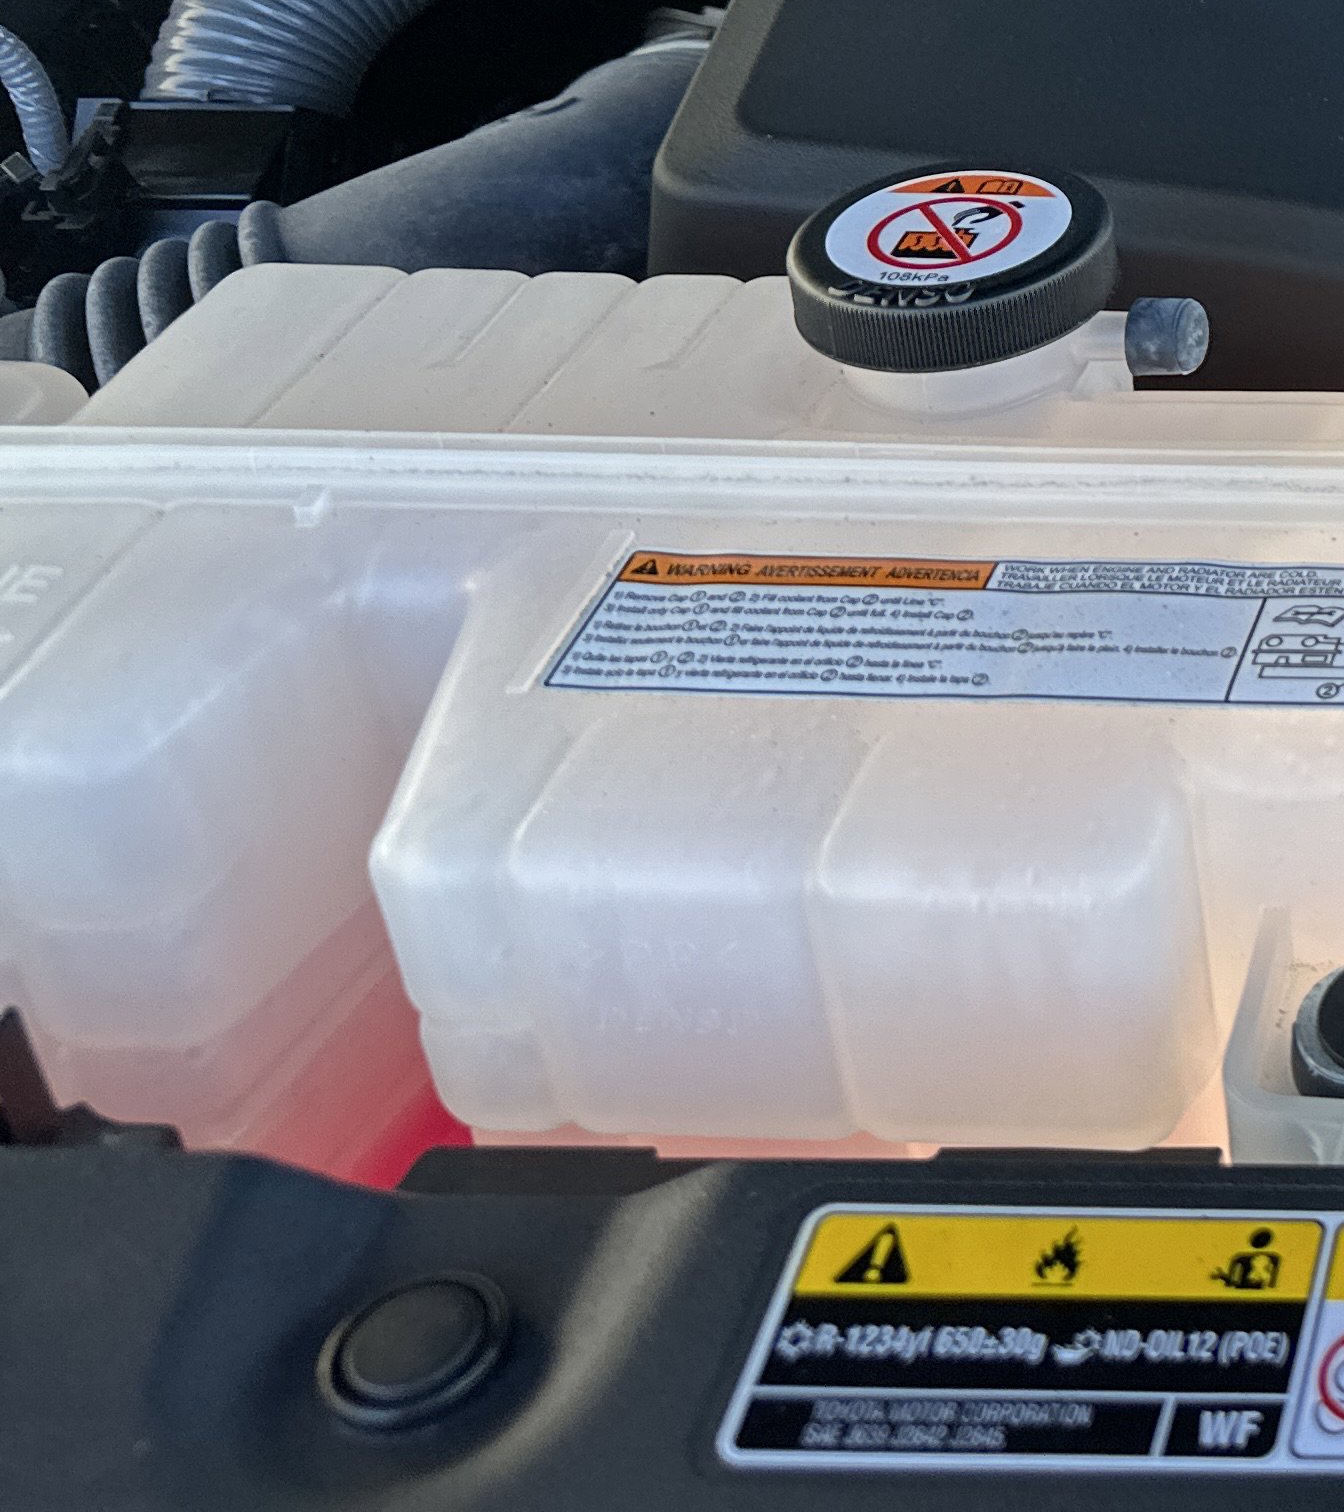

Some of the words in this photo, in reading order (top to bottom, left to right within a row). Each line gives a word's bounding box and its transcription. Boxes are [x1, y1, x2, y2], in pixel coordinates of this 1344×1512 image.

[879, 271, 951, 283] 108kPa
[666, 563, 751, 577] WARNING
[755, 563, 882, 579] AVERTISSEMENT
[884, 567, 981, 582] ADVERTENCIA
[1004, 565, 1046, 574] WORK
[1048, 565, 1091, 575] WHEN
[1092, 566, 1145, 575] ENGINE
[1146, 566, 1177, 575] AND
[1217, 1330, 1291, 1368] (POE)
[887, 1400, 958, 1424] MOTOR
[959, 1401, 1095, 1428] CORPORATION
[1198, 1409, 1265, 1449] WF
